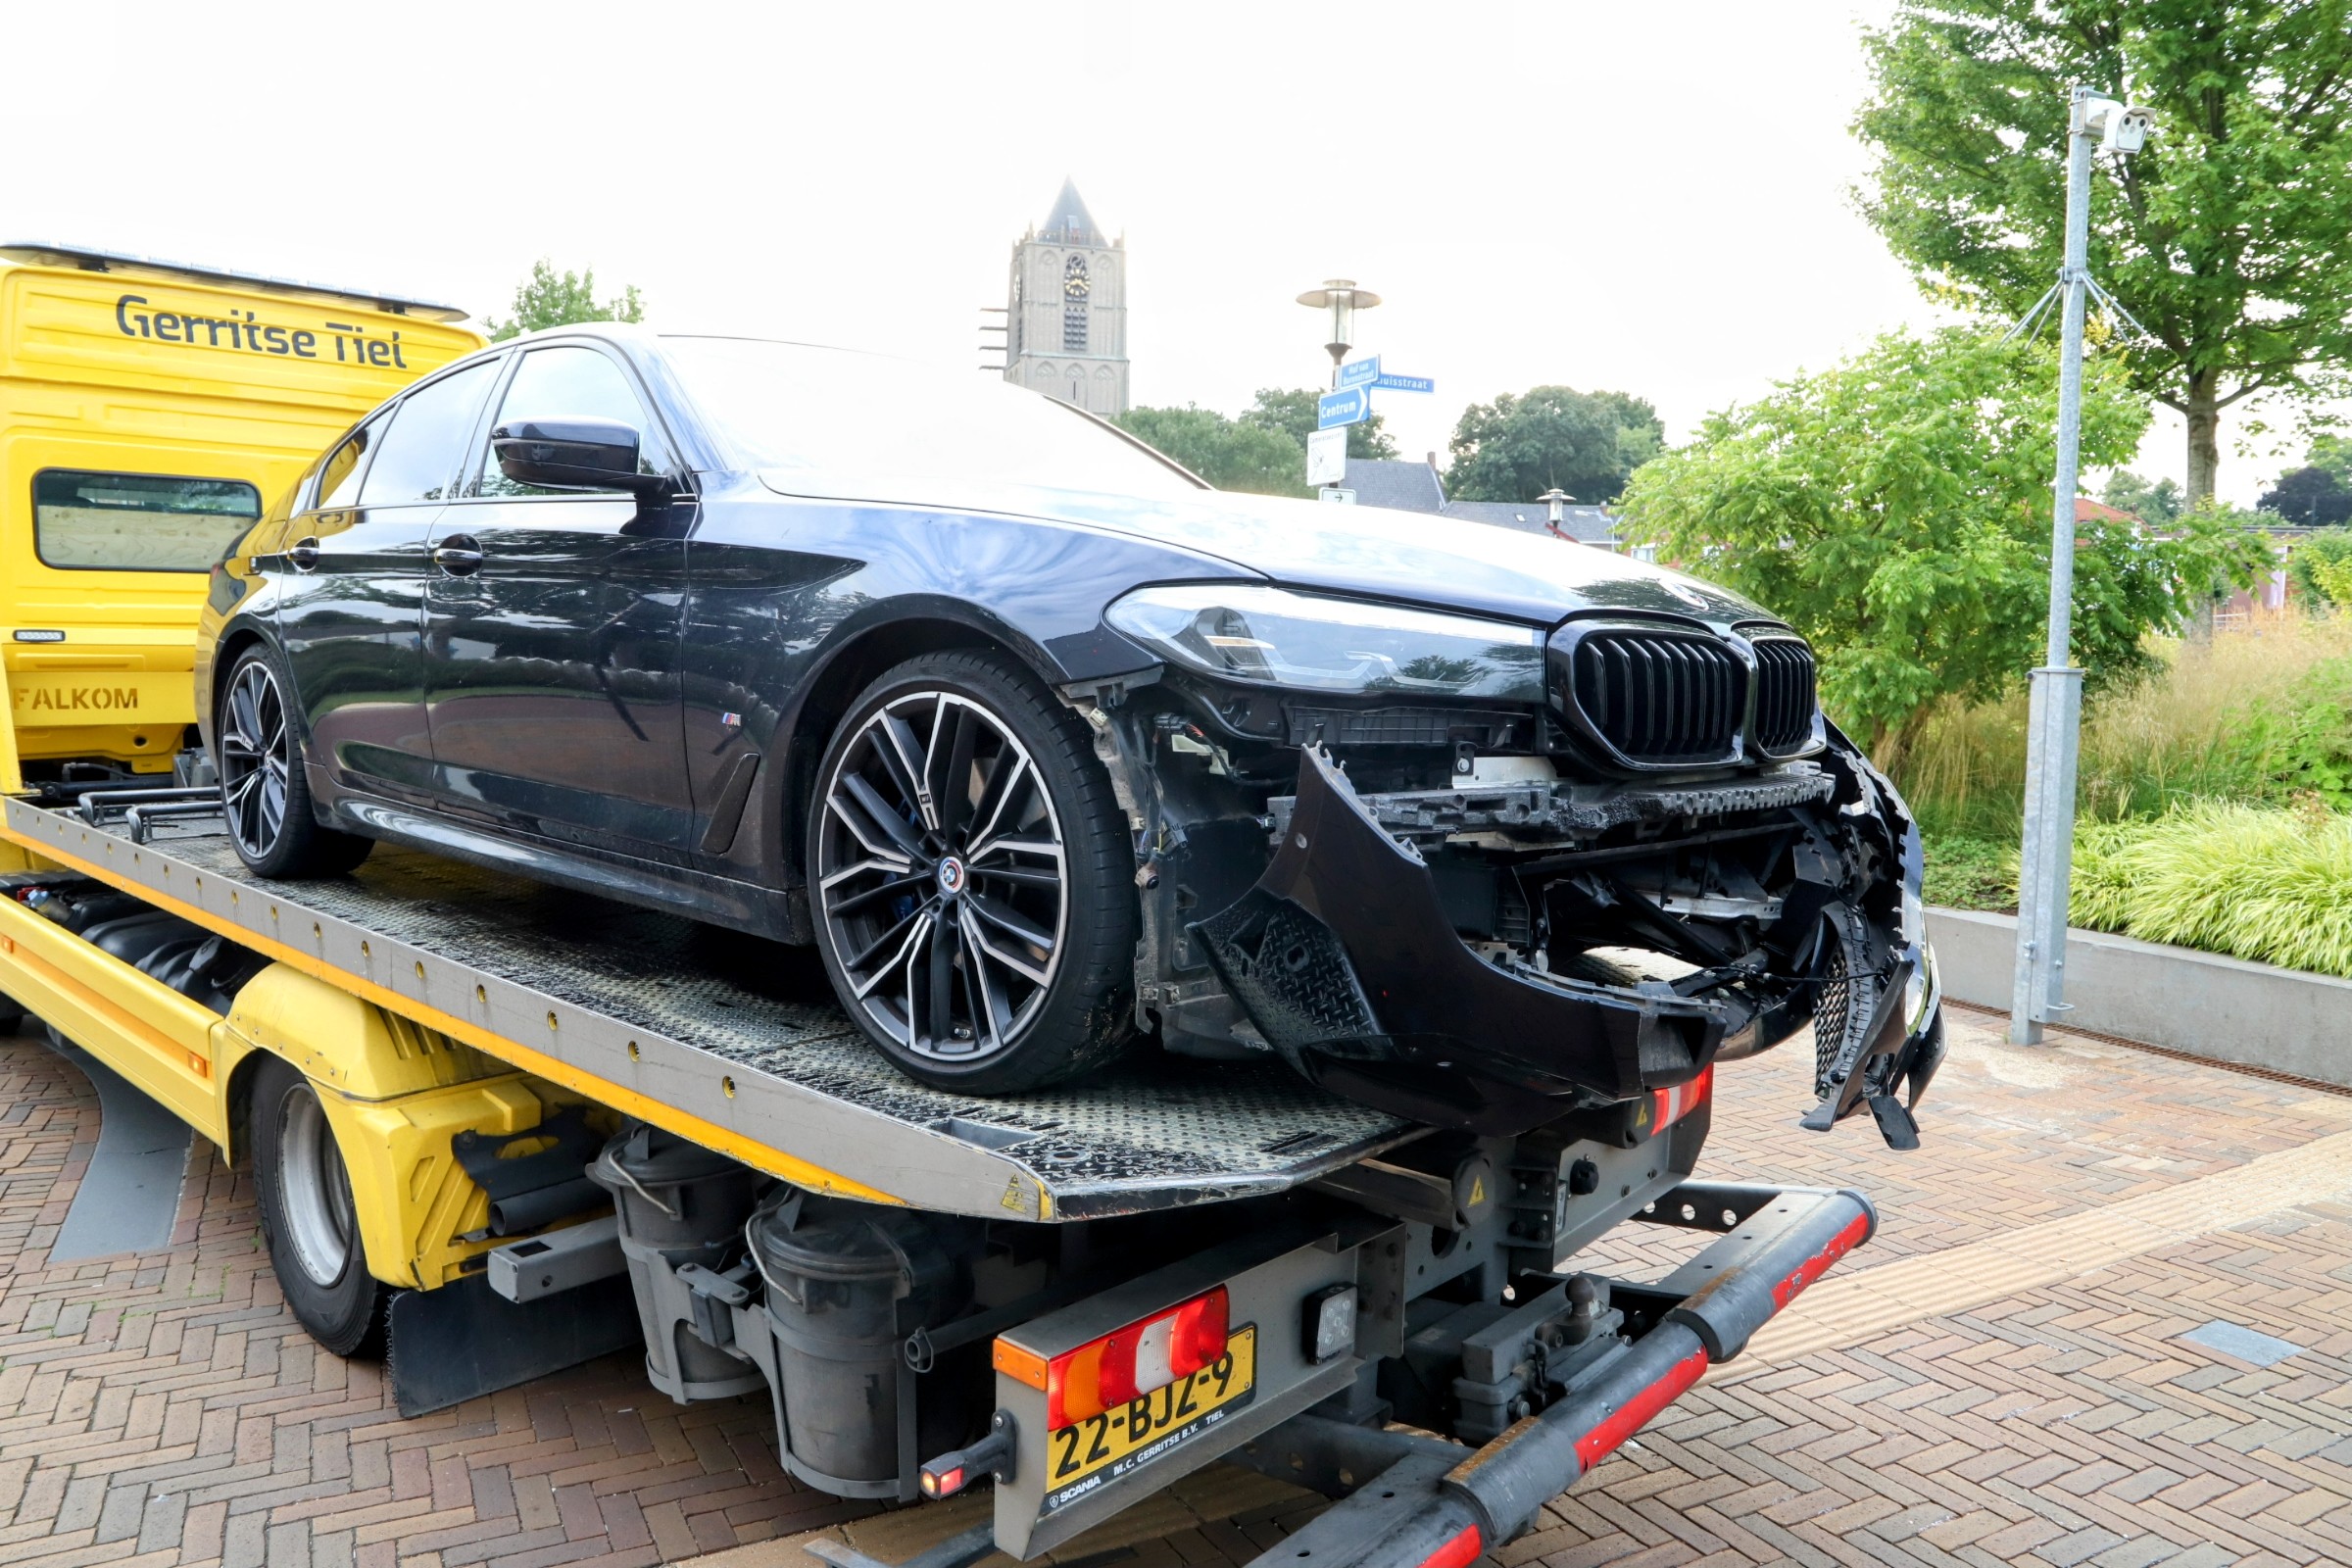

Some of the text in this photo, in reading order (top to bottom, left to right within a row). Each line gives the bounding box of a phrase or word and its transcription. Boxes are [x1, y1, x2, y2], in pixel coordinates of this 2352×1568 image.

[116, 294, 408, 368] Gerritse Tiel
[1321, 401, 1356, 418] Centrum
[13, 688, 138, 710] FALKOM
[1055, 1351, 1234, 1479] 22-BJZ-9
[1059, 1409, 1225, 1503] SCANIA M.C. GERRITSE B.V. TIEL
